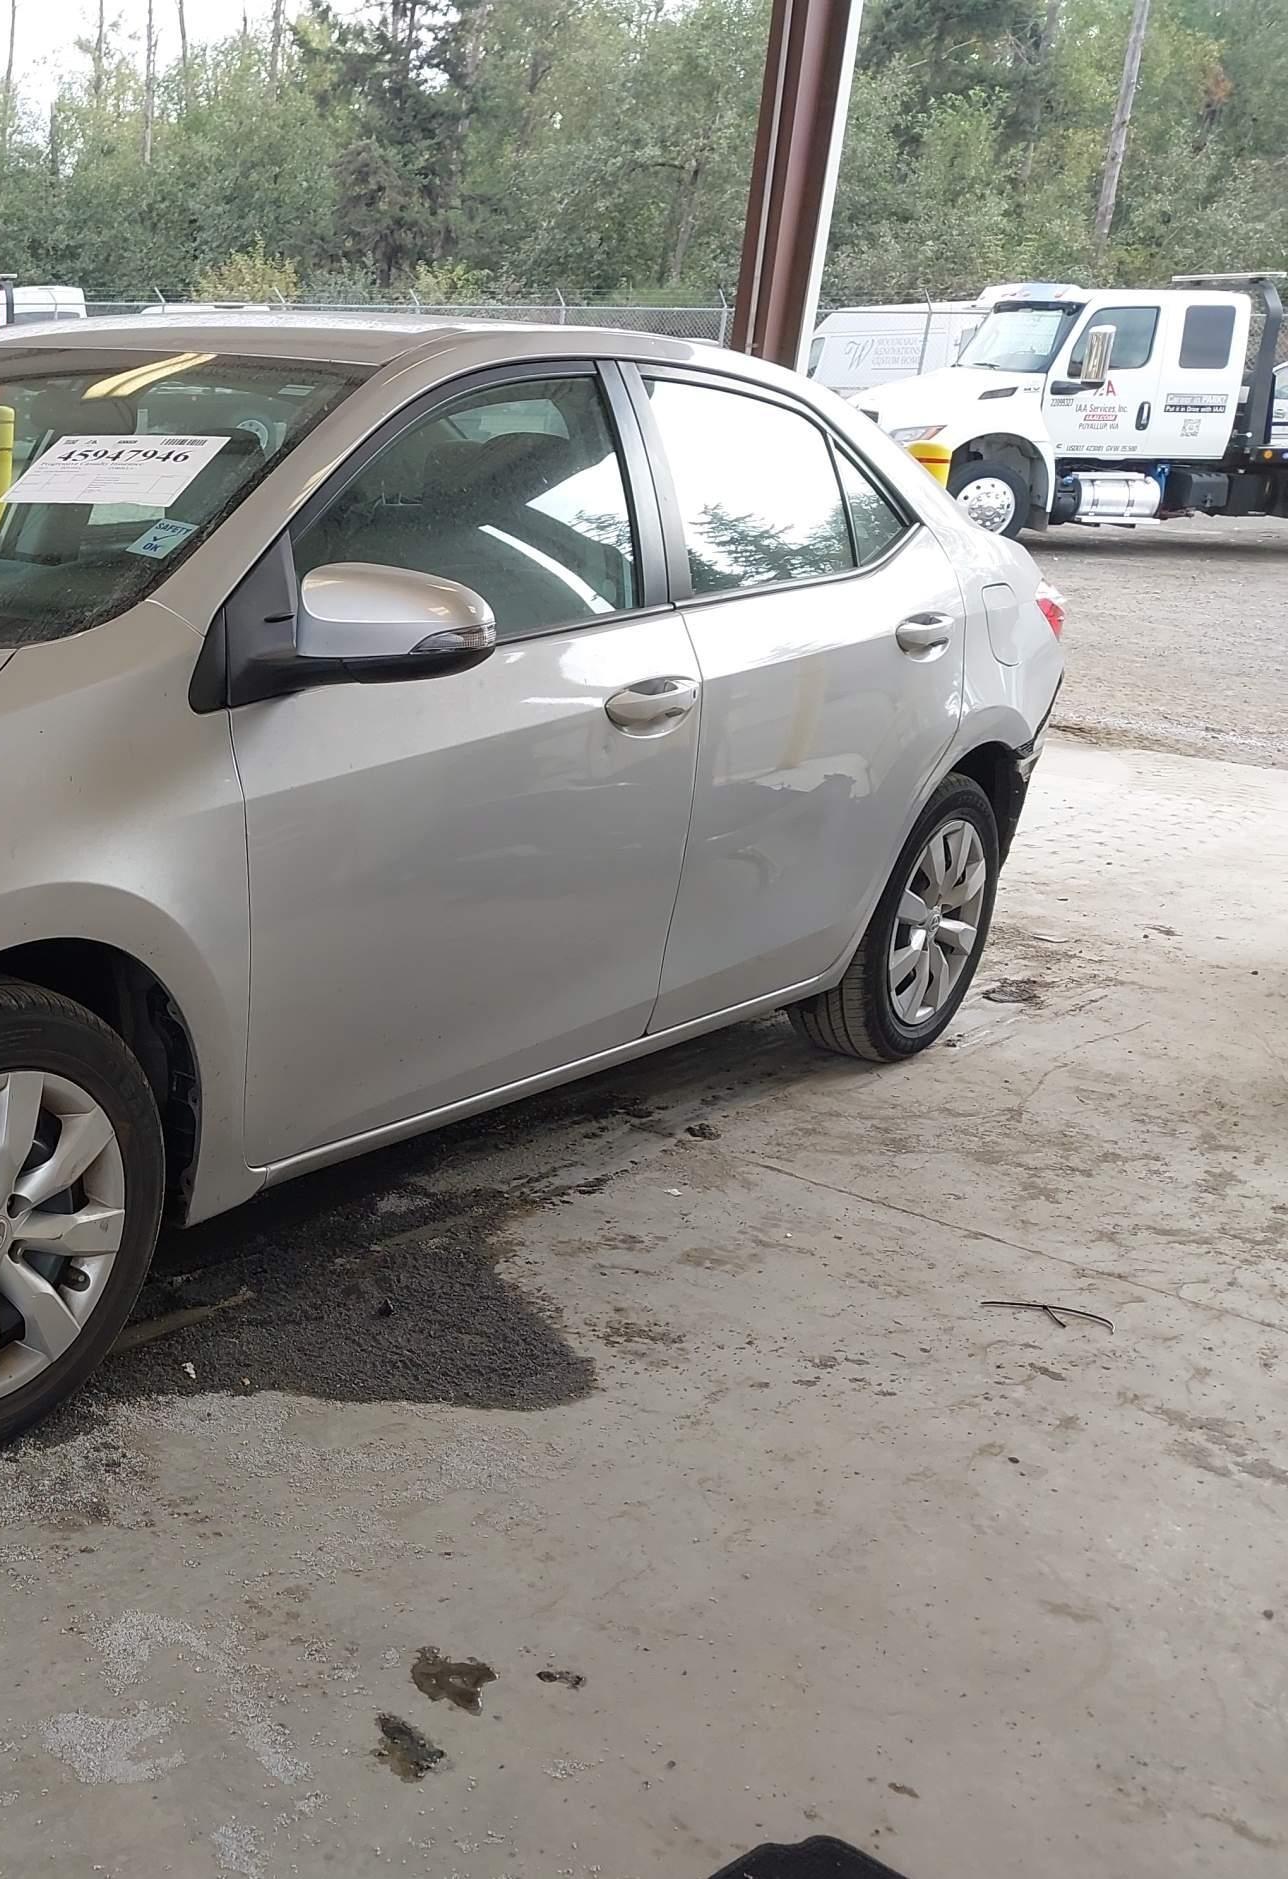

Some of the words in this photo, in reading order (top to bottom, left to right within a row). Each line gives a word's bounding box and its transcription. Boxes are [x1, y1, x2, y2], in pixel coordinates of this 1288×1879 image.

[57, 449, 194, 463] 45947946
[155, 522, 193, 535] SAFETY
[142, 542, 161, 552] OK
